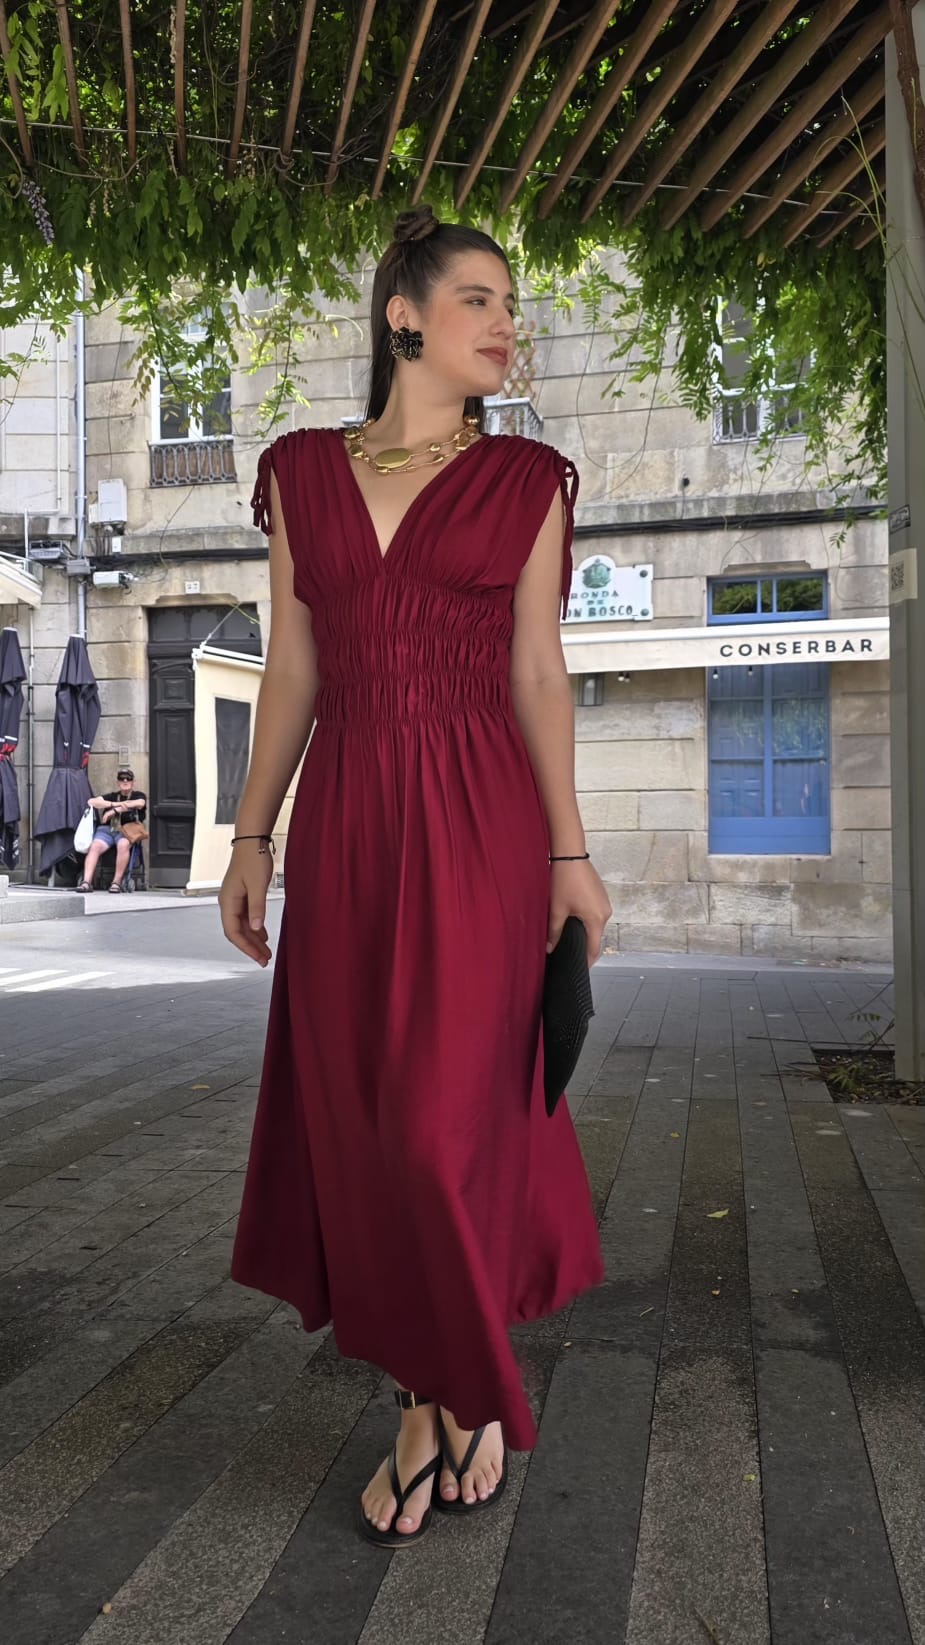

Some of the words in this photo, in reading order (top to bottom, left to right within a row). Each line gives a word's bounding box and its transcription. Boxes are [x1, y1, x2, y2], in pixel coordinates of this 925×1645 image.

[570, 590, 619, 600] RONDA
[588, 605, 633, 617] BOSCO
[719, 638, 873, 657] CONSERBAR
